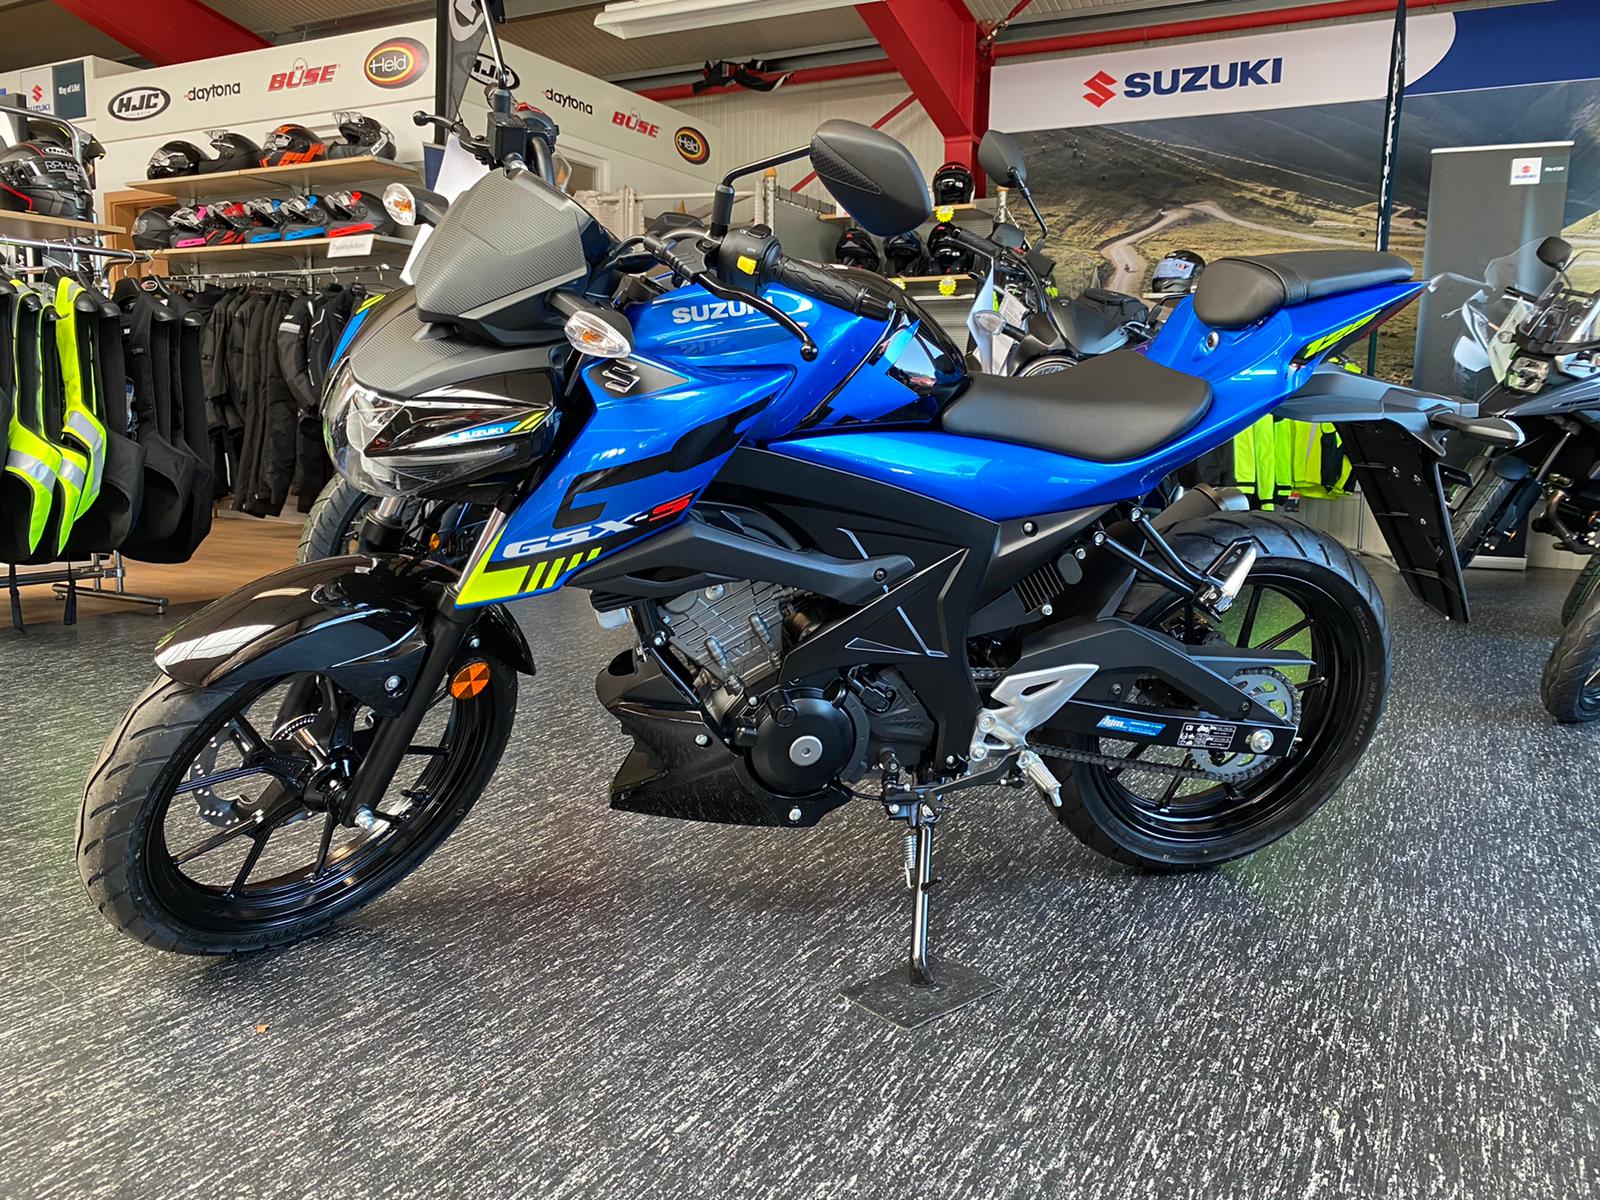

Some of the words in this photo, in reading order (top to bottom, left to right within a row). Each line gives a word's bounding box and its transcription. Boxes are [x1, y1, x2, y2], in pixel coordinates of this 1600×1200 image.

[370, 54, 407, 74] Held
[267, 64, 338, 92] BÜSE
[1123, 57, 1283, 99] SUZUKI
[117, 92, 160, 114] HJC
[187, 82, 241, 102] daytona
[545, 88, 593, 115] daytona
[612, 111, 660, 138] BÜSE
[678, 136, 699, 153] Held
[459, 426, 505, 439] SUZUKI
[502, 493, 693, 559] GSX-S
